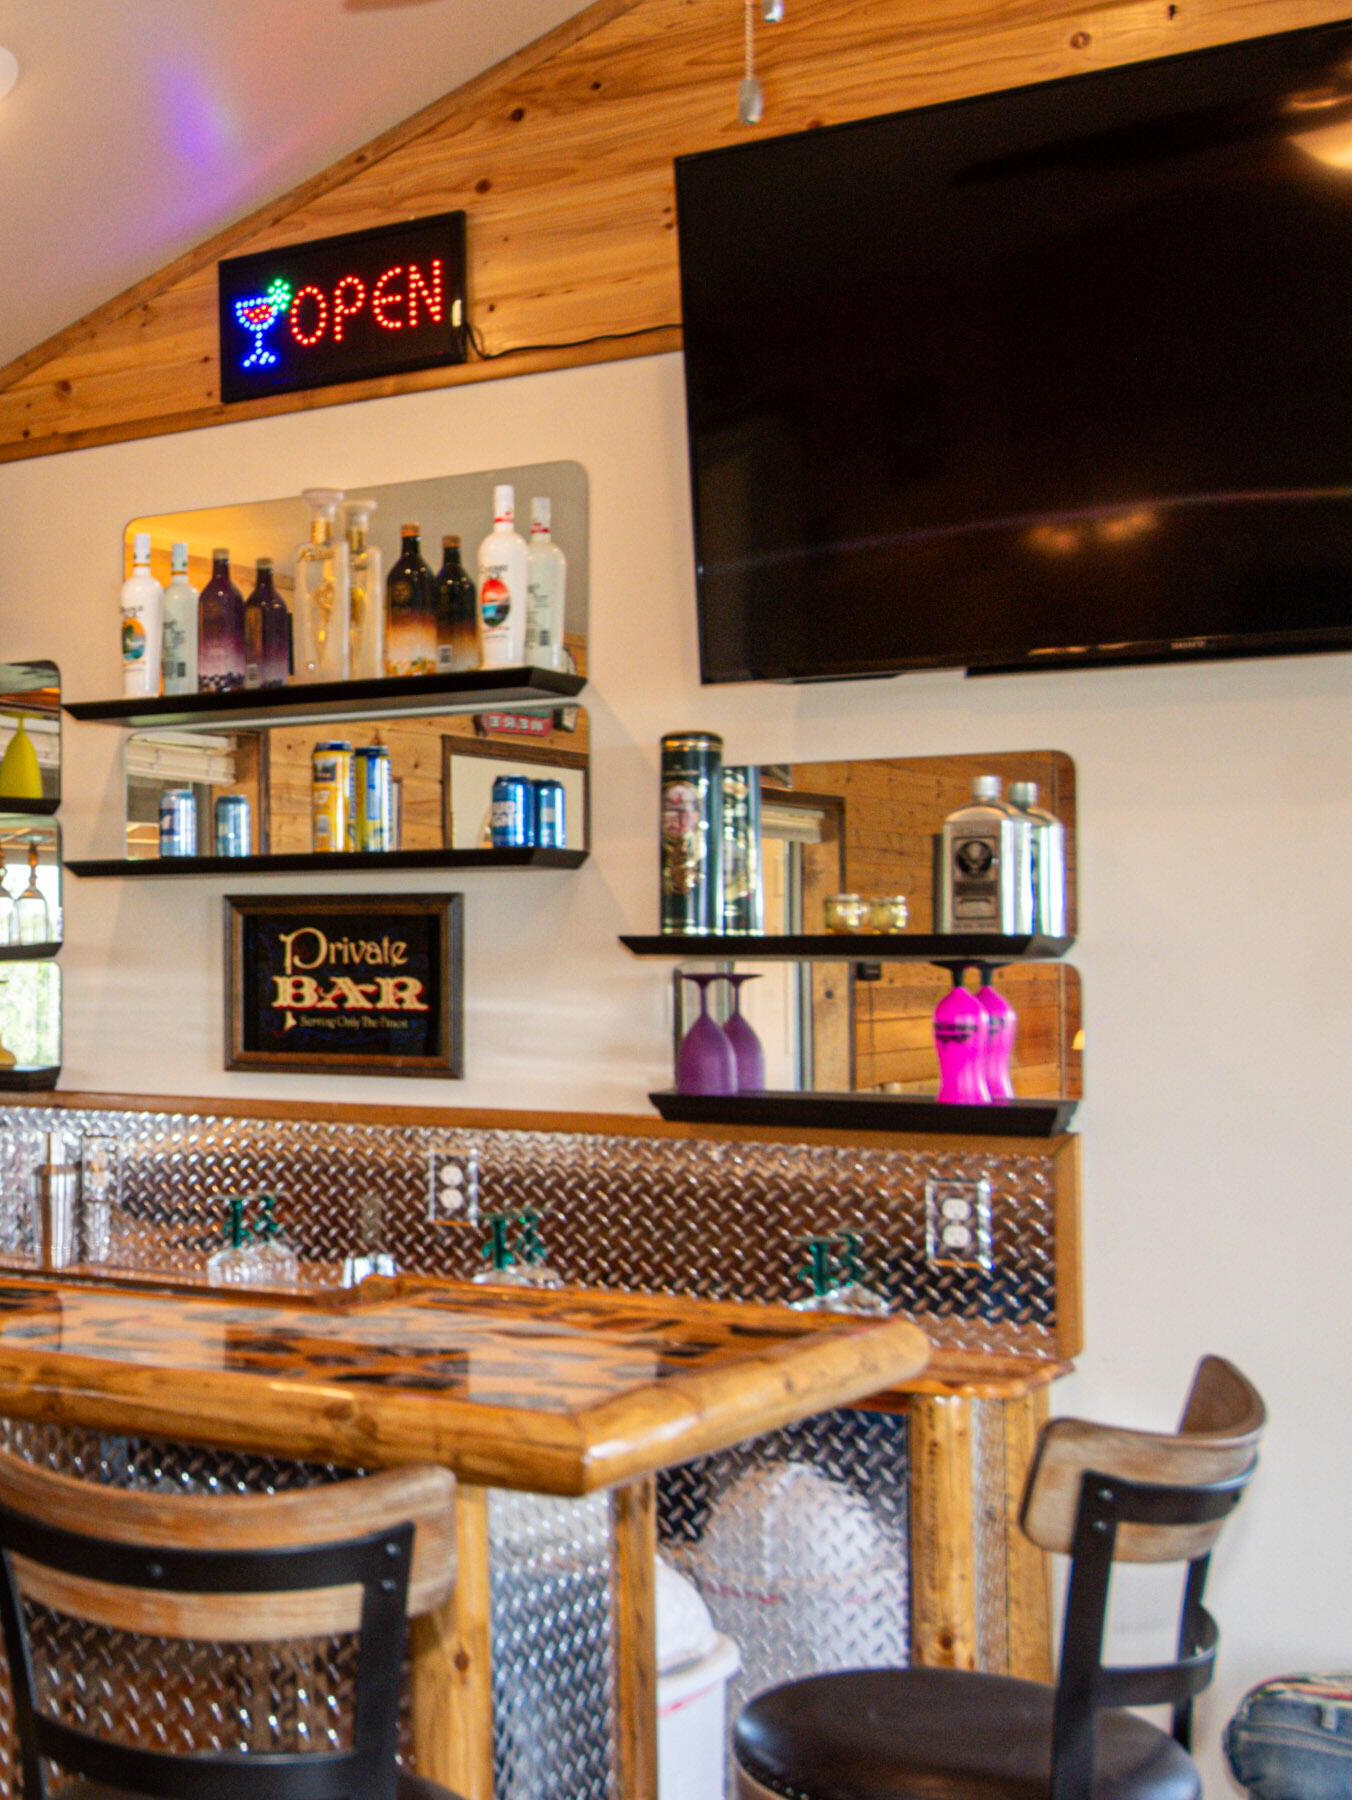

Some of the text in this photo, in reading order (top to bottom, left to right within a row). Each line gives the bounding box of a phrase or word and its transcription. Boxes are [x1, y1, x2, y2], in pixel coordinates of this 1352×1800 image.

[290, 258, 443, 346] OPEN
[278, 926, 409, 976] Private
[271, 975, 430, 1012] BAR
